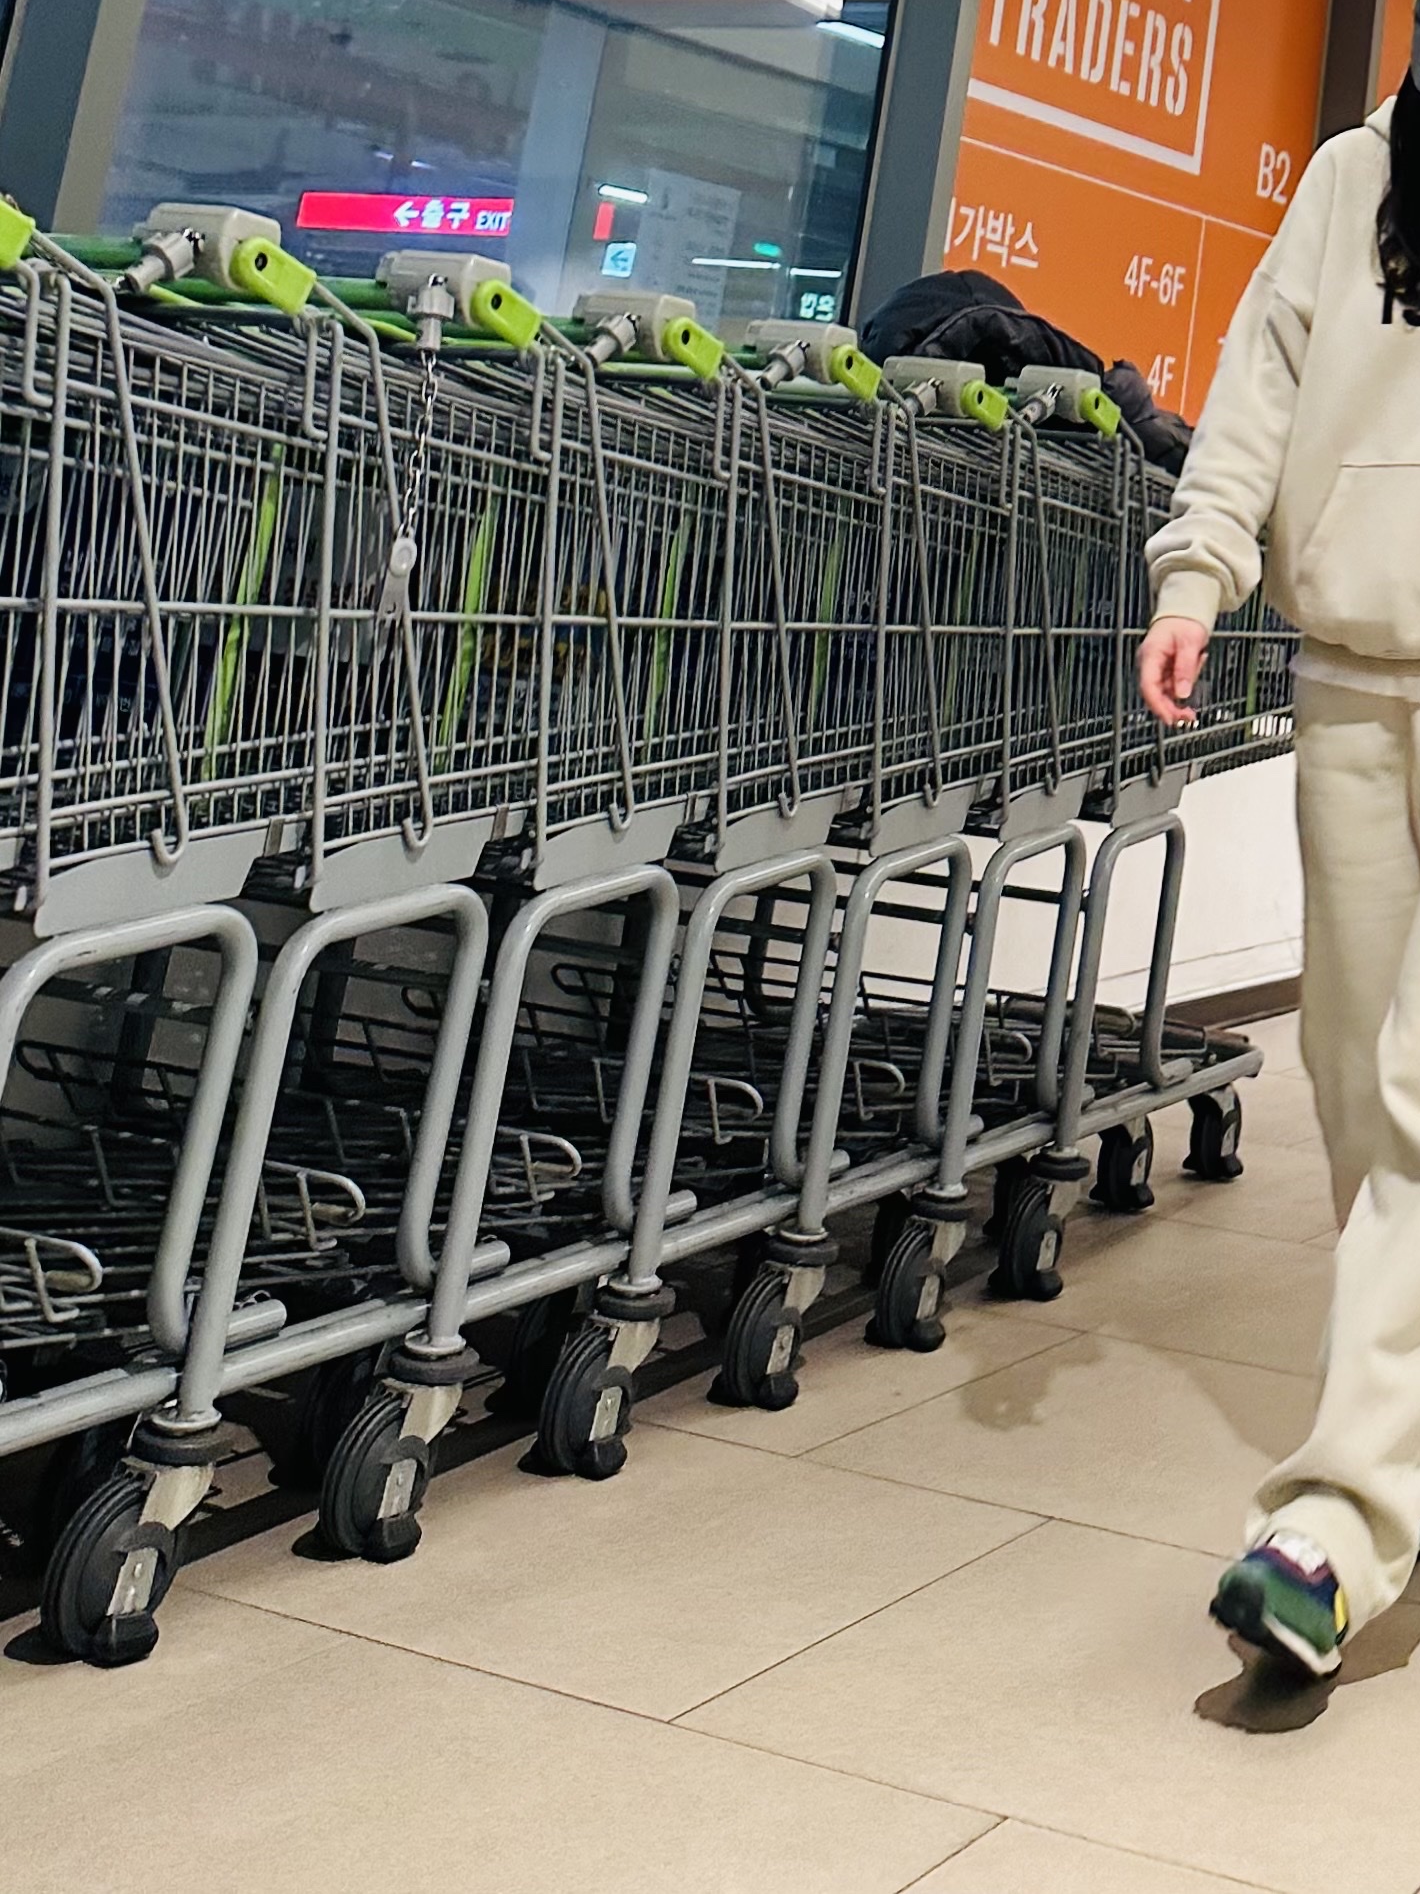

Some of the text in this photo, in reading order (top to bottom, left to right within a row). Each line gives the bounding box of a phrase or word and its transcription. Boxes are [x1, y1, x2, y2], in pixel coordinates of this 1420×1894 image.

[1255, 142, 1292, 207] B2
[475, 210, 512, 232] EXIT
[944, 196, 1187, 307] 가박스 4F-6F
[1147, 353, 1176, 398] 4F
